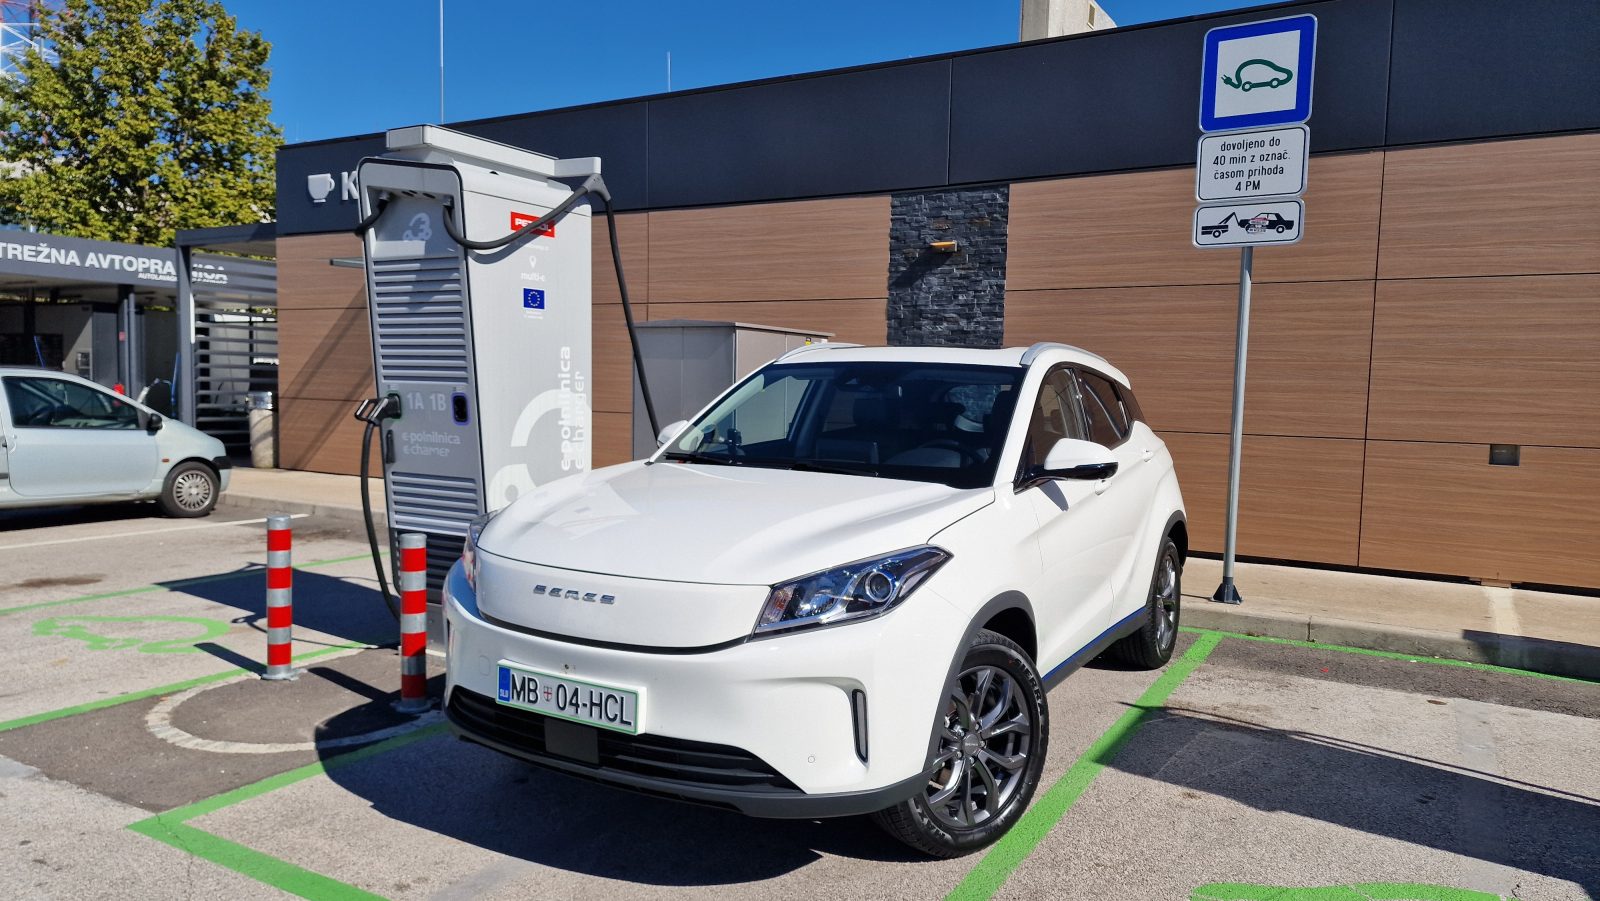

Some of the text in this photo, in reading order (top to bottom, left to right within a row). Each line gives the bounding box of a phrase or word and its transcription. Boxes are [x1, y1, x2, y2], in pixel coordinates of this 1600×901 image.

[1220, 136, 1281, 152] dovoljeno do
[1213, 150, 1291, 166] 40 min z označ.
[1214, 165, 1284, 180] časom prihoda
[1235, 180, 1261, 191] 4 PM
[407, 392, 447, 411] 1A 1B
[511, 673, 632, 726] MB 04-HCL
